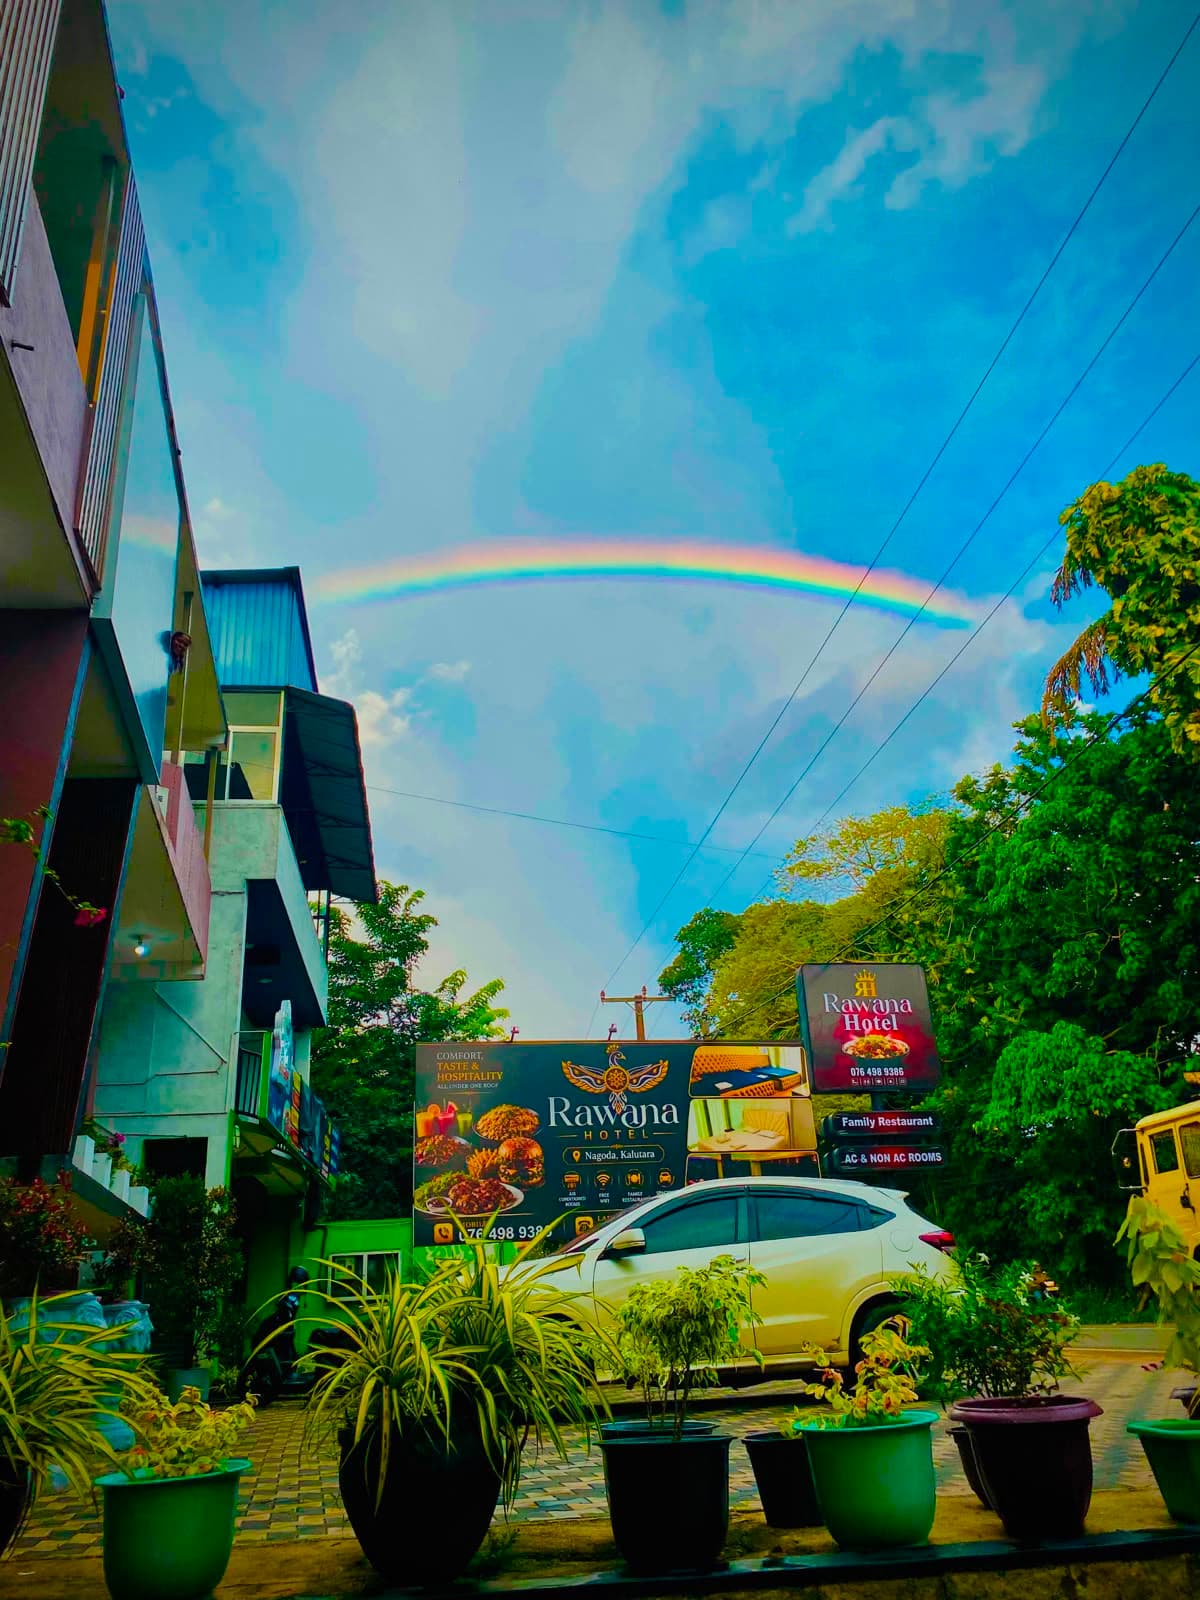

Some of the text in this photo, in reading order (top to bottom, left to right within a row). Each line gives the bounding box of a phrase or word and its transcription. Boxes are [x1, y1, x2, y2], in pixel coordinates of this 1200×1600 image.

[823, 993, 913, 1016] Rawana
[843, 1014, 899, 1031] Hotel
[436, 1051, 484, 1060] COMFORT,
[437, 1062, 480, 1071] TASTE &
[850, 1067, 865, 1077] 076
[866, 1067, 882, 1077] 498
[436, 1071, 504, 1081] HOSPITALITY
[547, 1096, 680, 1129] Rawana
[842, 1116, 934, 1129] Family Restaurant
[584, 1129, 649, 1140] HOTEL
[585, 1150, 655, 1161] Nagoda, Kalutara
[844, 1152, 943, 1164] AC & NON AC ROOMS
[489, 1227, 514, 1240] 498
